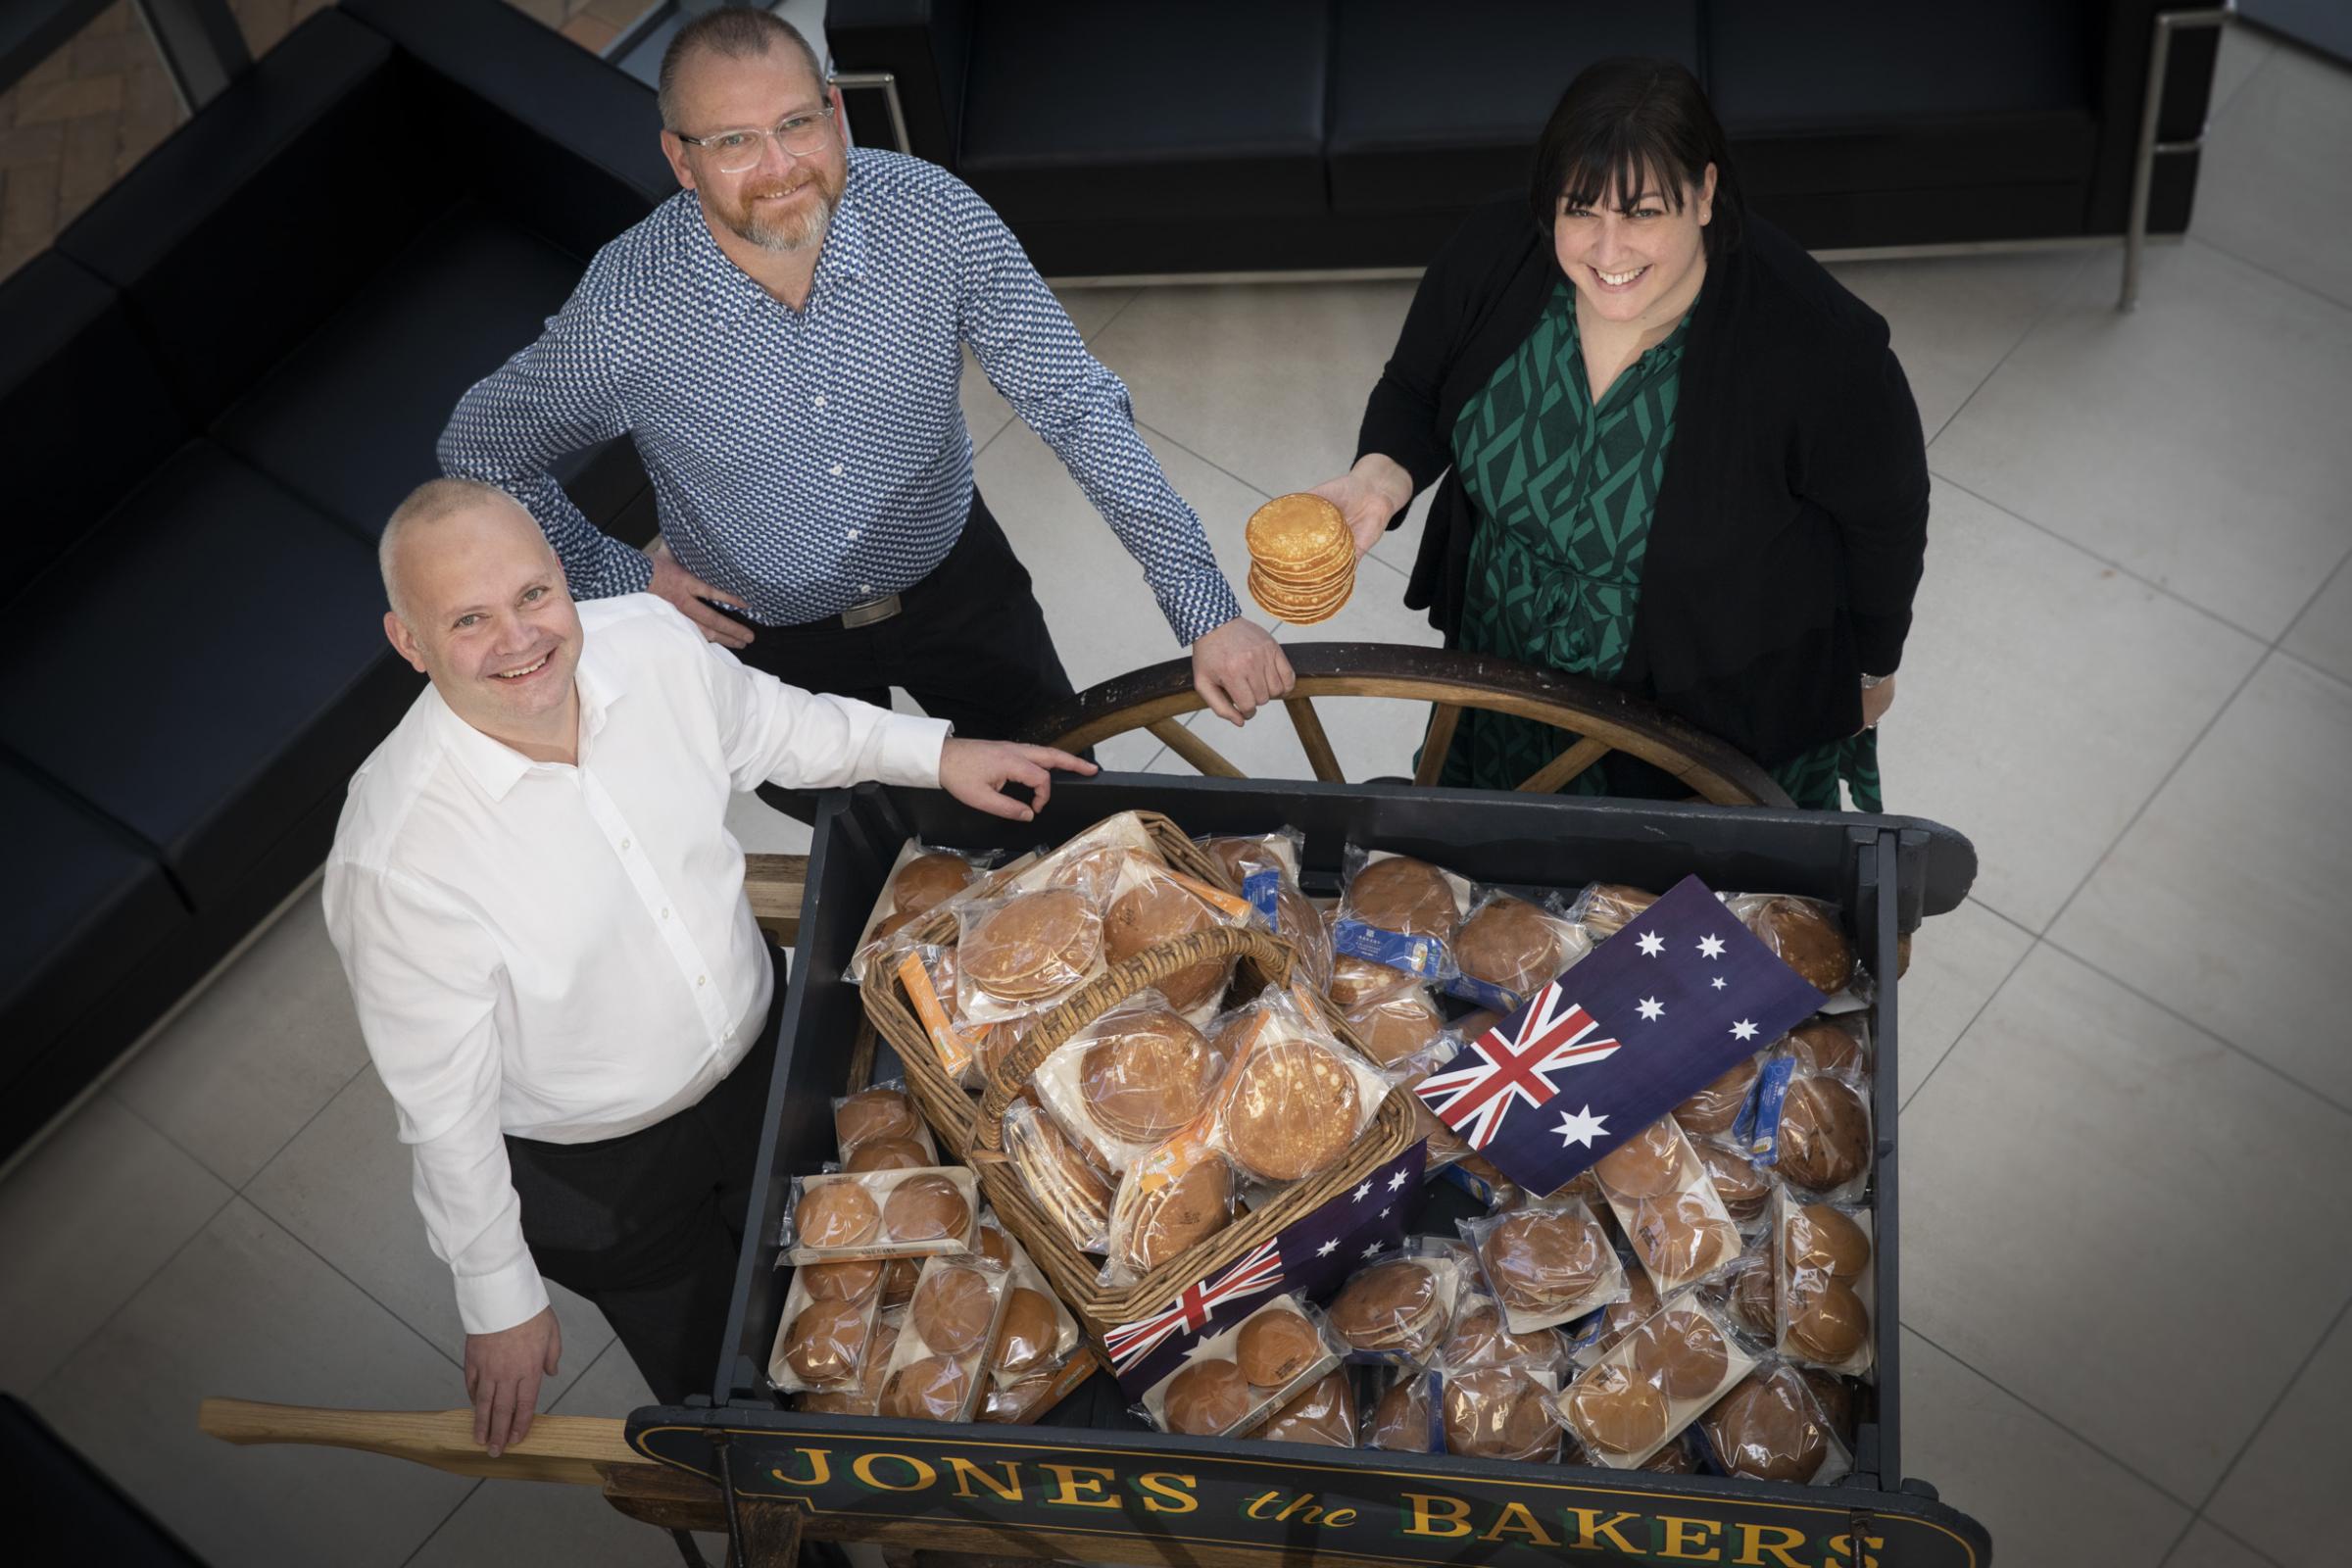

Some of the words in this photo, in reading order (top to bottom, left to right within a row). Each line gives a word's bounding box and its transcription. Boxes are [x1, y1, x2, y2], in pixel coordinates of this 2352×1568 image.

[772, 1447, 1199, 1514] JONES
[1245, 1491, 1357, 1528] the
[1401, 1493, 1884, 1568] BAKERS
